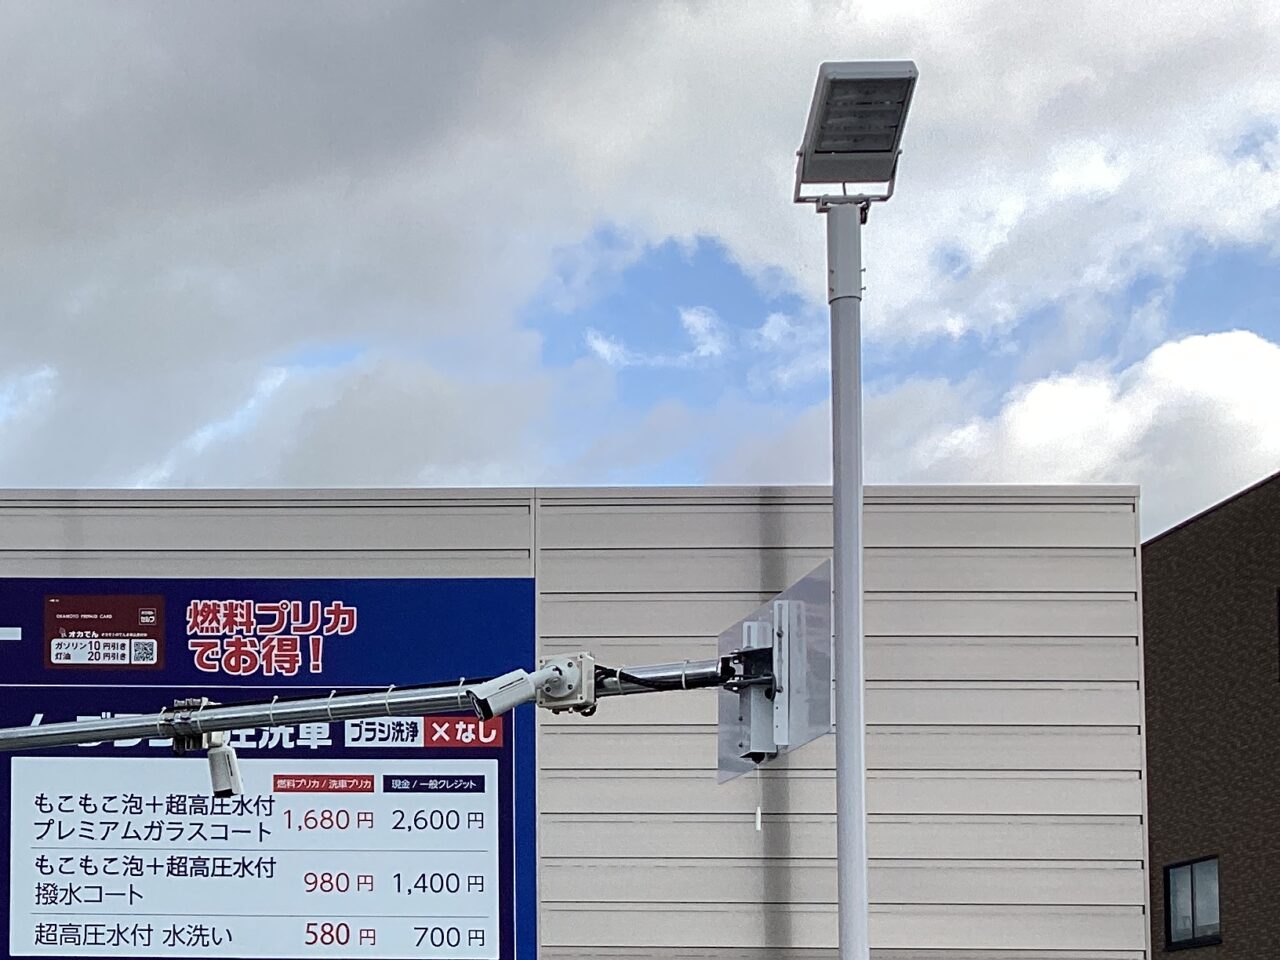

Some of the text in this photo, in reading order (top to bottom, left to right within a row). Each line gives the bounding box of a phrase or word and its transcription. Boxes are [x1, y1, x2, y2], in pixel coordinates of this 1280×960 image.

[187, 600, 357, 635] 燃料プリカ
[68, 630, 99, 638] オカでん
[55, 652, 71, 660] 灯油
[189, 636, 324, 676] でお得!
[350, 720, 419, 743] ブラシ洗浄
[277, 780, 320, 789] 燃料プリカ
[328, 780, 372, 789] 洗車プリカ
[392, 780, 410, 789] 現金
[420, 780, 477, 789] 一般クレジット
[34, 793, 275, 816] もこもこ泡+超高圧水付
[34, 819, 272, 842] プレミアムガラスコート
[283, 809, 350, 831] 1,680
[391, 809, 460, 832] 2,600
[35, 855, 277, 878] もこもこ泡+超高圧水付
[35, 882, 144, 905] 撥水コート
[303, 872, 350, 893] 980
[393, 873, 460, 895] 1,400
[34, 923, 154, 947] 超高圧水付
[162, 923, 233, 947] 水洗い
[304, 922, 350, 945] 580
[413, 927, 461, 947] 700
